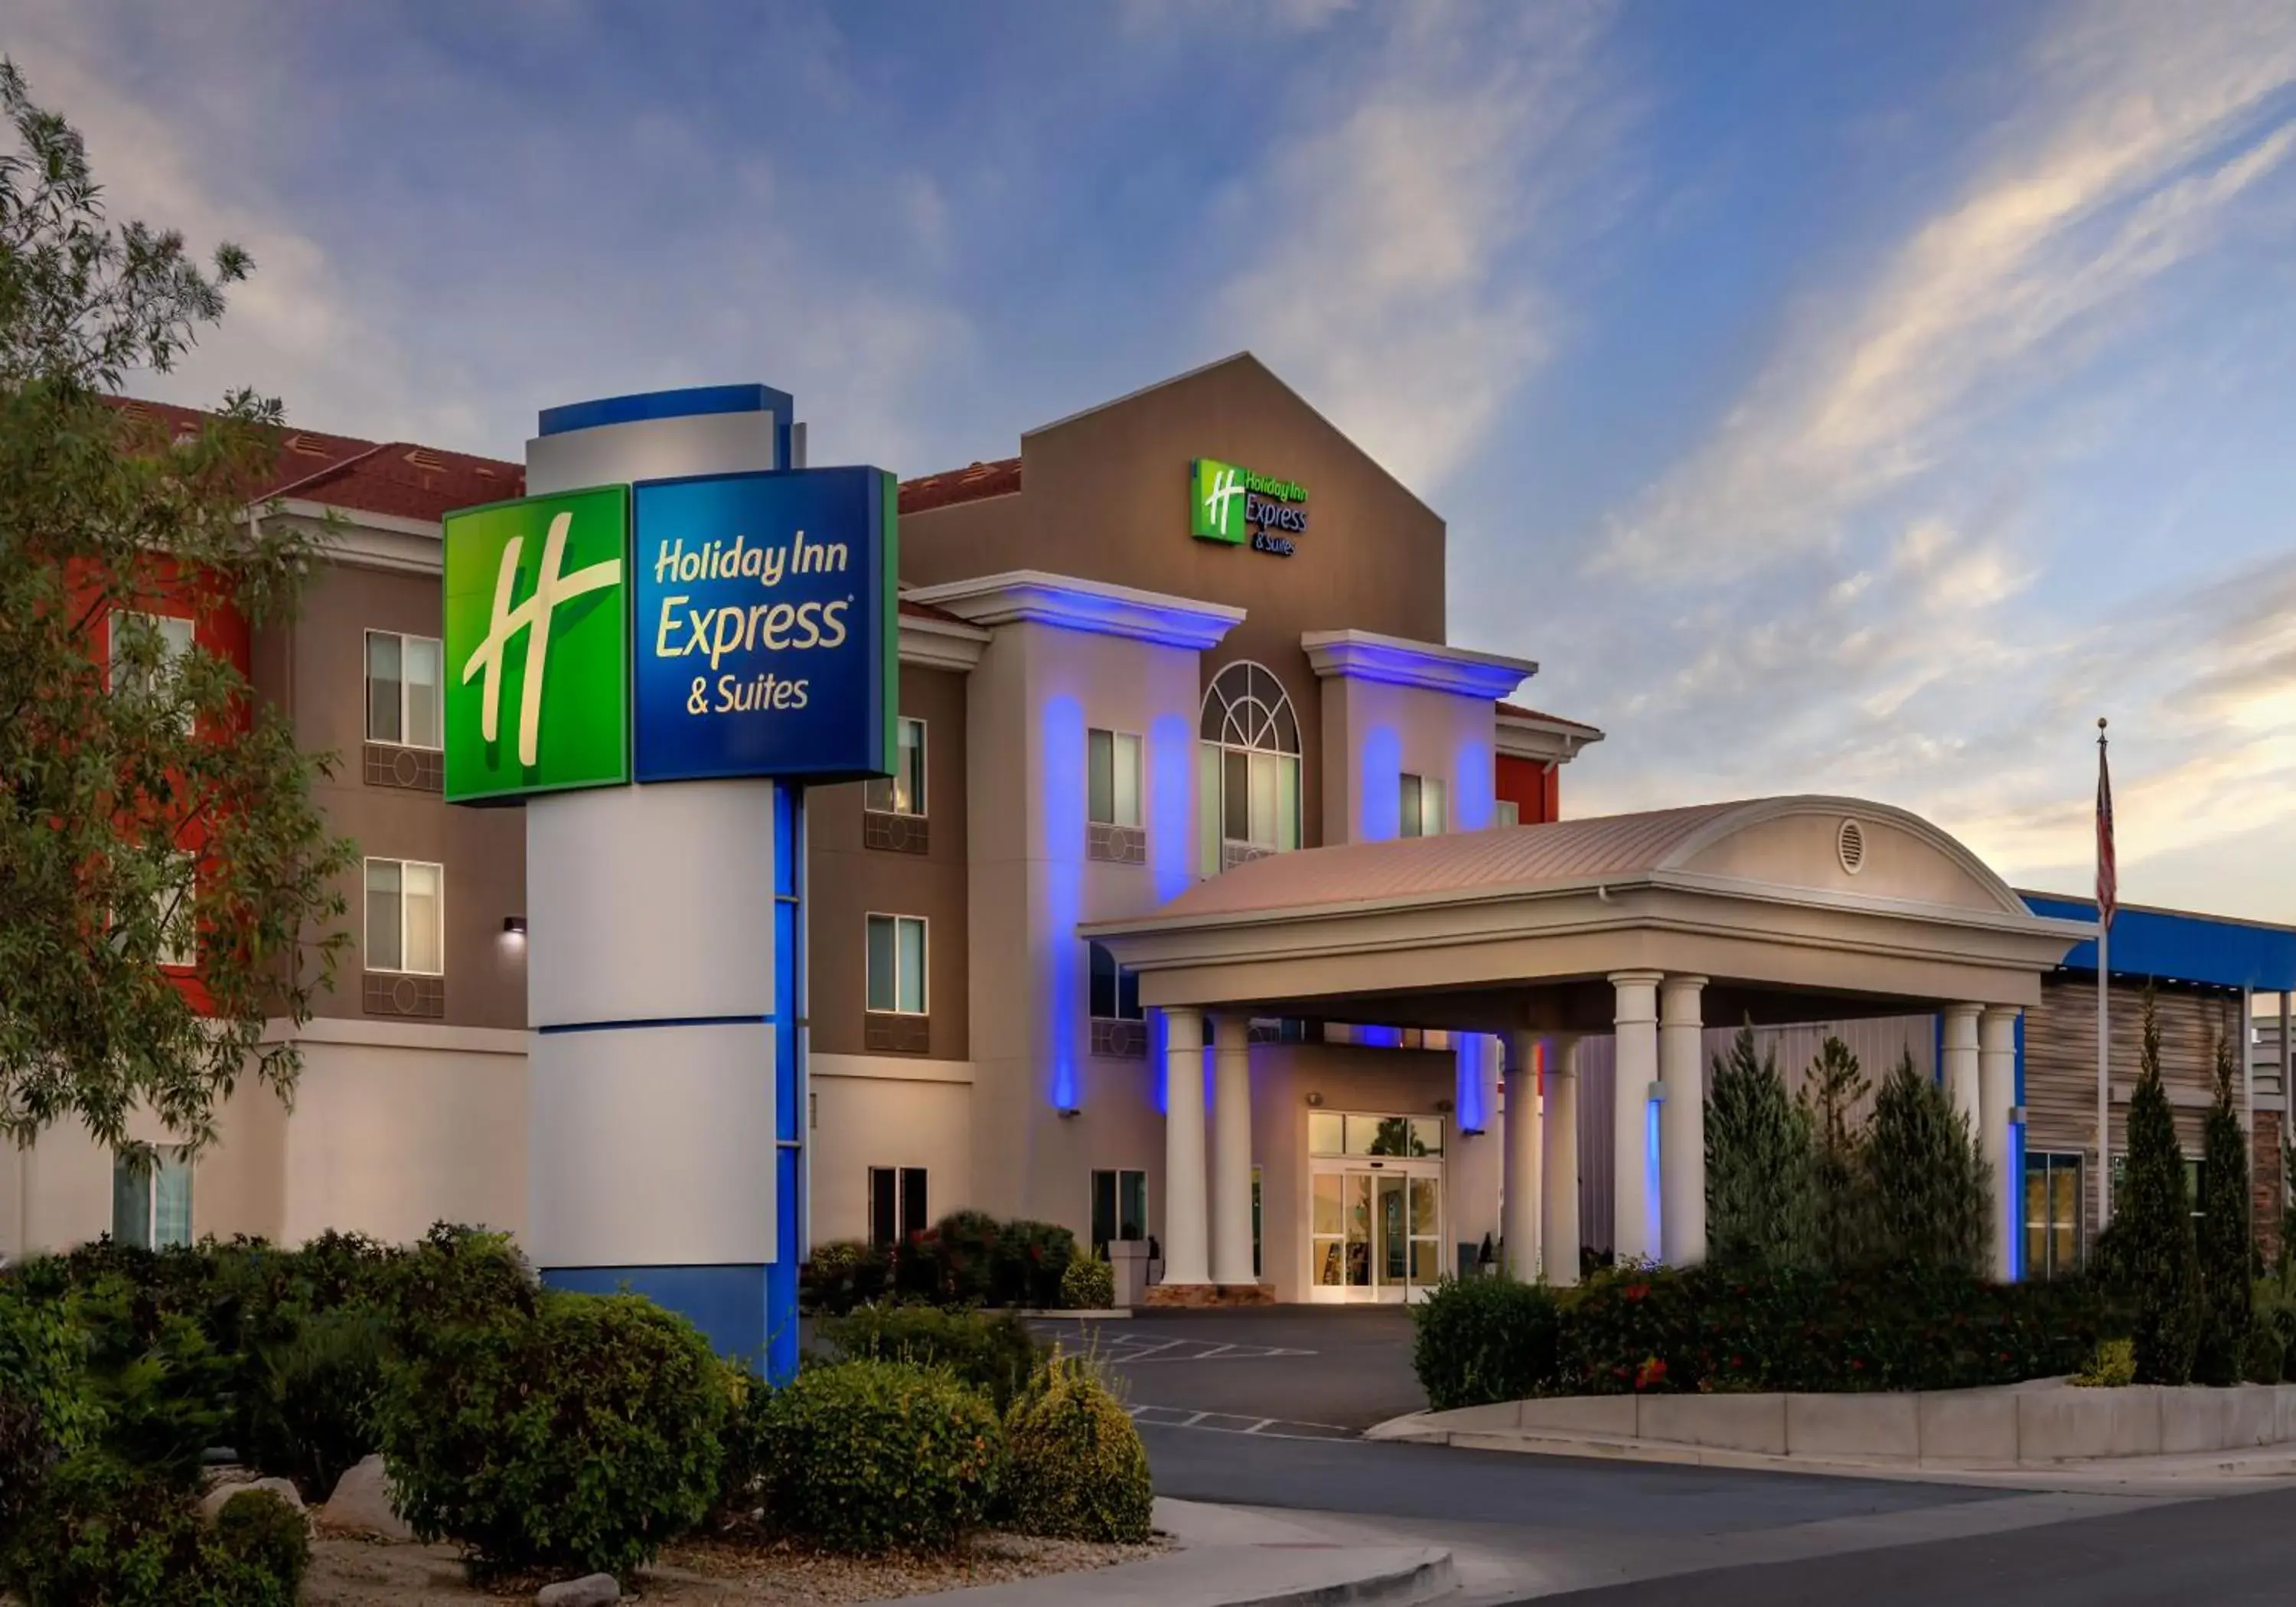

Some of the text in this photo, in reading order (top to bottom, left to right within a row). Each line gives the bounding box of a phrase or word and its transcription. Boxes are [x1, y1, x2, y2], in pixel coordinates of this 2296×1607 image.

[1245, 470, 1307, 502] Holiday Inn
[1245, 493, 1307, 531] Express
[655, 530, 848, 587] Holiday Inn
[1256, 531, 1296, 555] & Suites
[656, 595, 849, 670] Express
[687, 673, 809, 715] & Suites
